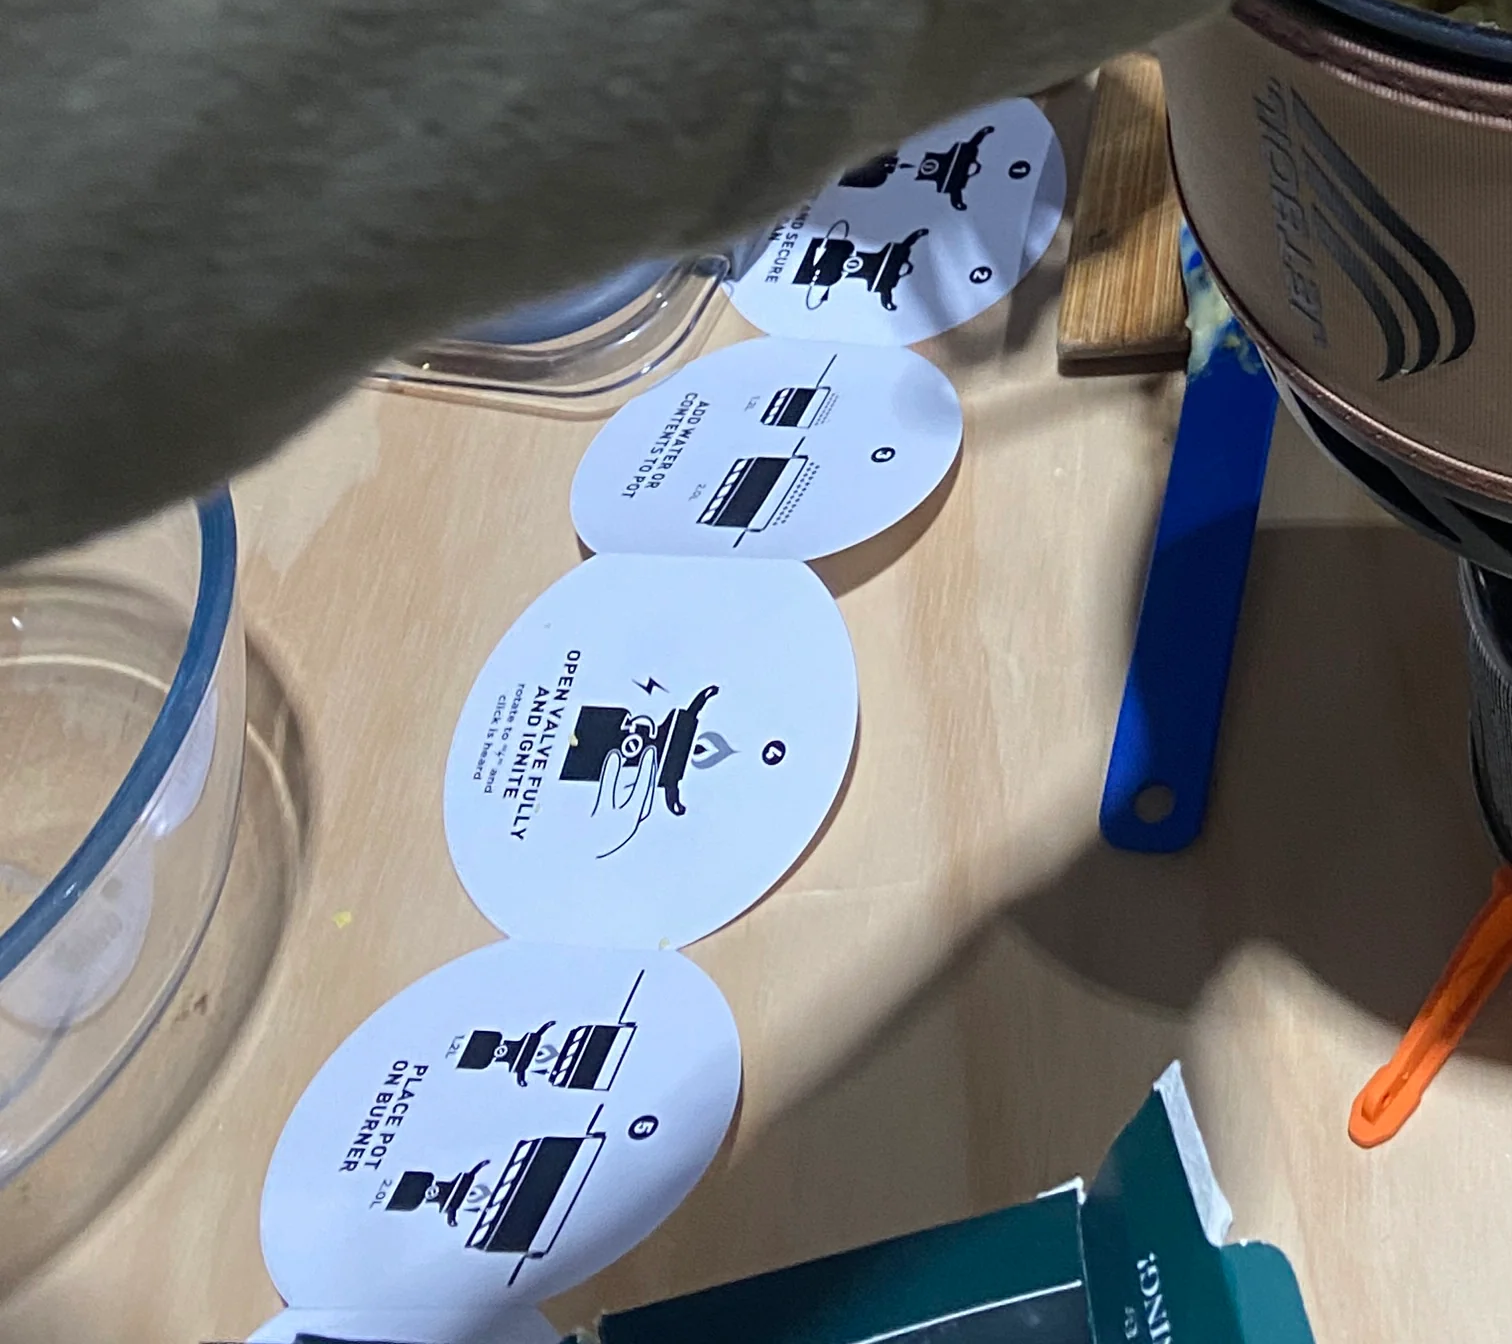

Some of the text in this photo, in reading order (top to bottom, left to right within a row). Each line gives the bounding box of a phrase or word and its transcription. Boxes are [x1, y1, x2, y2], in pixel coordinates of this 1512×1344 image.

[764, 232, 799, 284] SECURE
[621, 392, 699, 499] CONTENTS TO POT
[643, 400, 710, 490] ADD WATER OR
[484, 683, 526, 794] rotate to and
[491, 694, 507, 725] click
[503, 686, 550, 799] AND IGNITE
[510, 649, 582, 841] OPEN VALVE FULLY
[473, 742, 493, 781] heard
[445, 1035, 465, 1059] 1.2L
[339, 1060, 408, 1172] ON BURNER
[364, 1064, 429, 1170] PLACE POT
[370, 1179, 392, 1209] 2.0L
